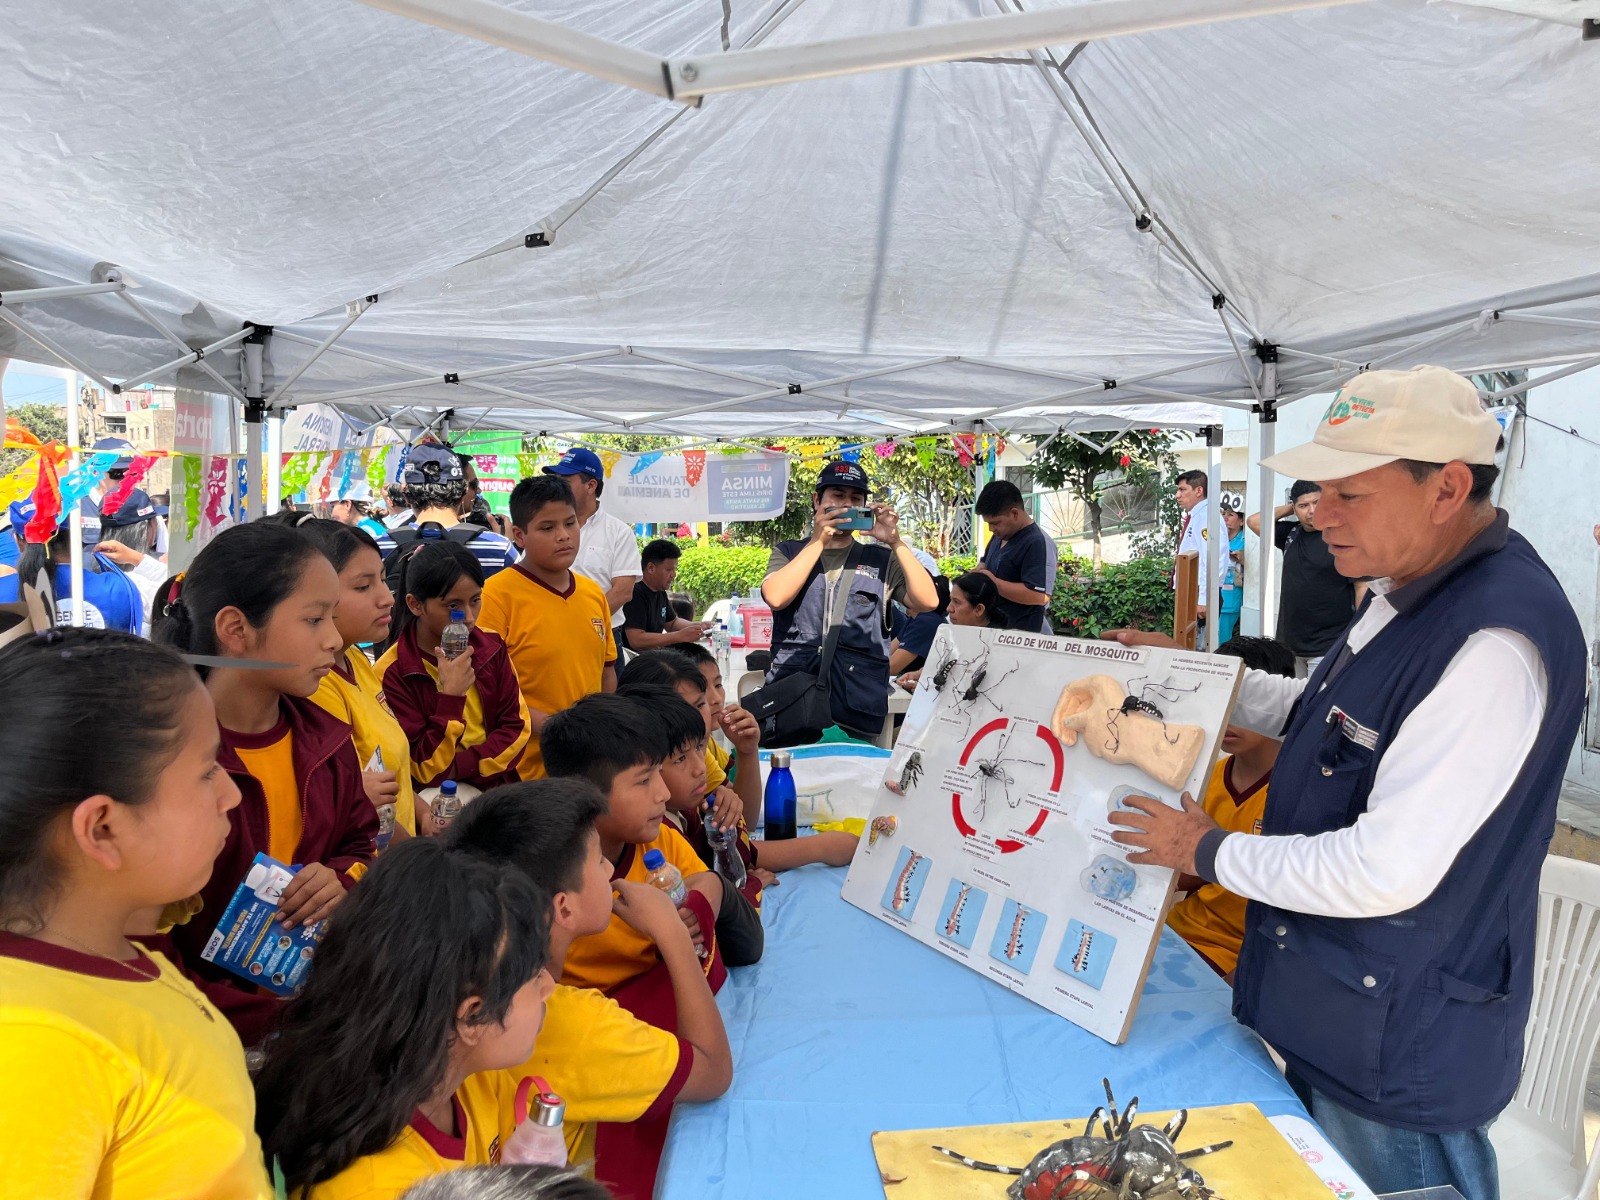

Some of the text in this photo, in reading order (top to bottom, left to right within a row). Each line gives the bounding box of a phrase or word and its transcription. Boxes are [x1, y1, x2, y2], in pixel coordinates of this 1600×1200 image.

[478, 480, 514, 492] engue
[56, 609, 92, 622] GEE
[998, 634, 1140, 662] CICLO DE VIDA DEL MOSQUITO
[204, 936, 220, 958] SORIA
